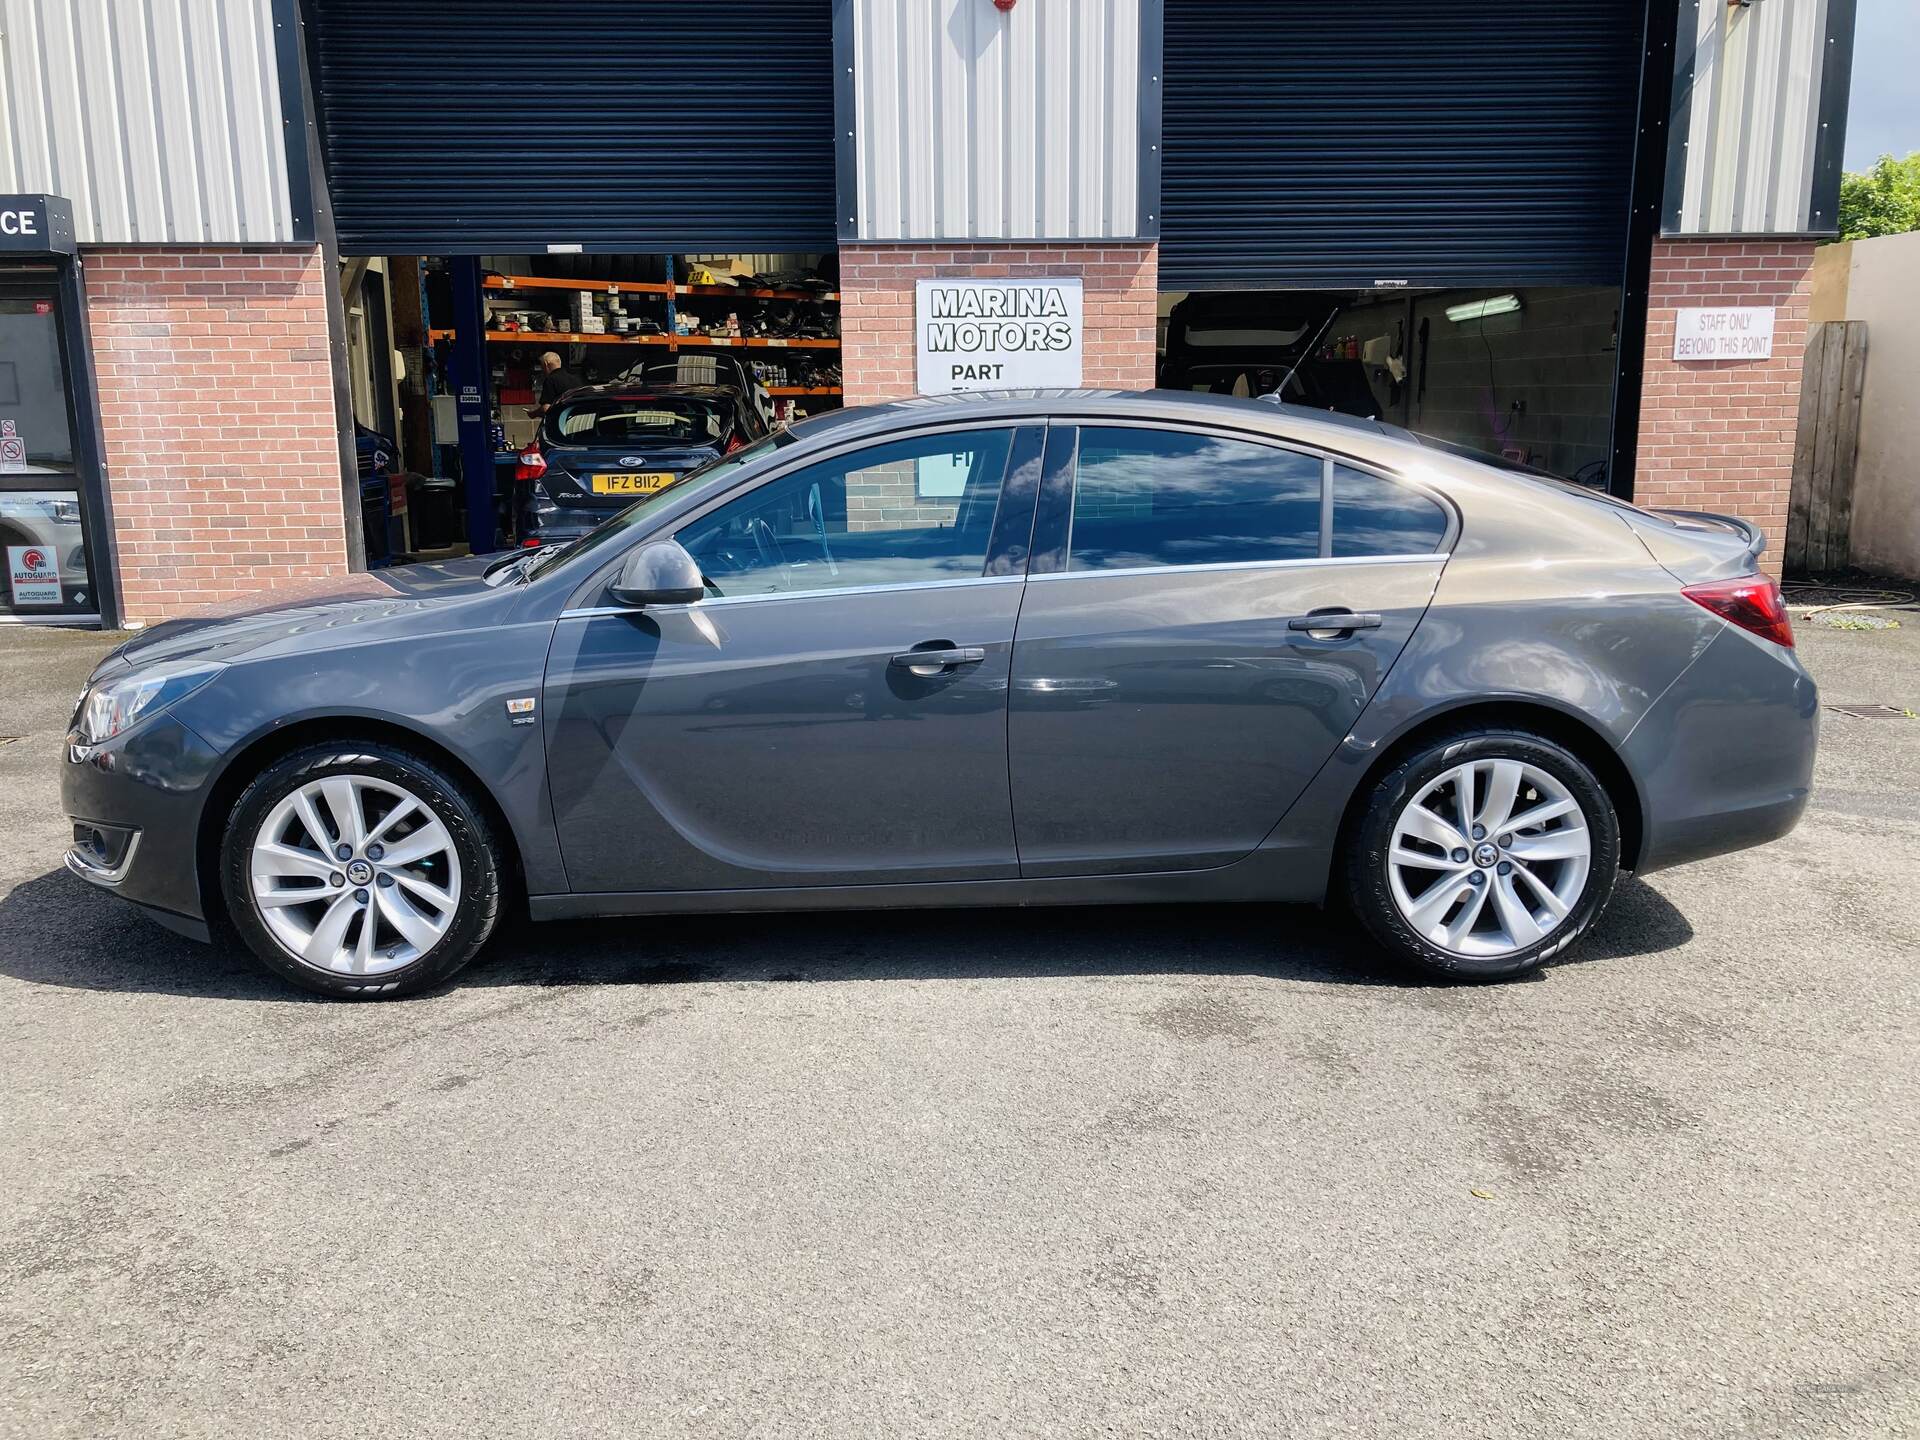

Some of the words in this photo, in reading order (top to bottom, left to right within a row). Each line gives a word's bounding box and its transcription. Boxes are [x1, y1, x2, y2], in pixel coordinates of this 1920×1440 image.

[931, 288, 1068, 318] MARINA
[1700, 313, 1727, 331] STAFF
[1729, 312, 1752, 331] ONLY
[927, 322, 1072, 352] MOTORS
[1679, 337, 1716, 354] BEYOND
[1719, 337, 1740, 354] THIS
[1742, 336, 1768, 354] POINT
[952, 364, 1004, 380] PART
[607, 476, 630, 489] IFZ
[634, 475, 660, 488] 8112
